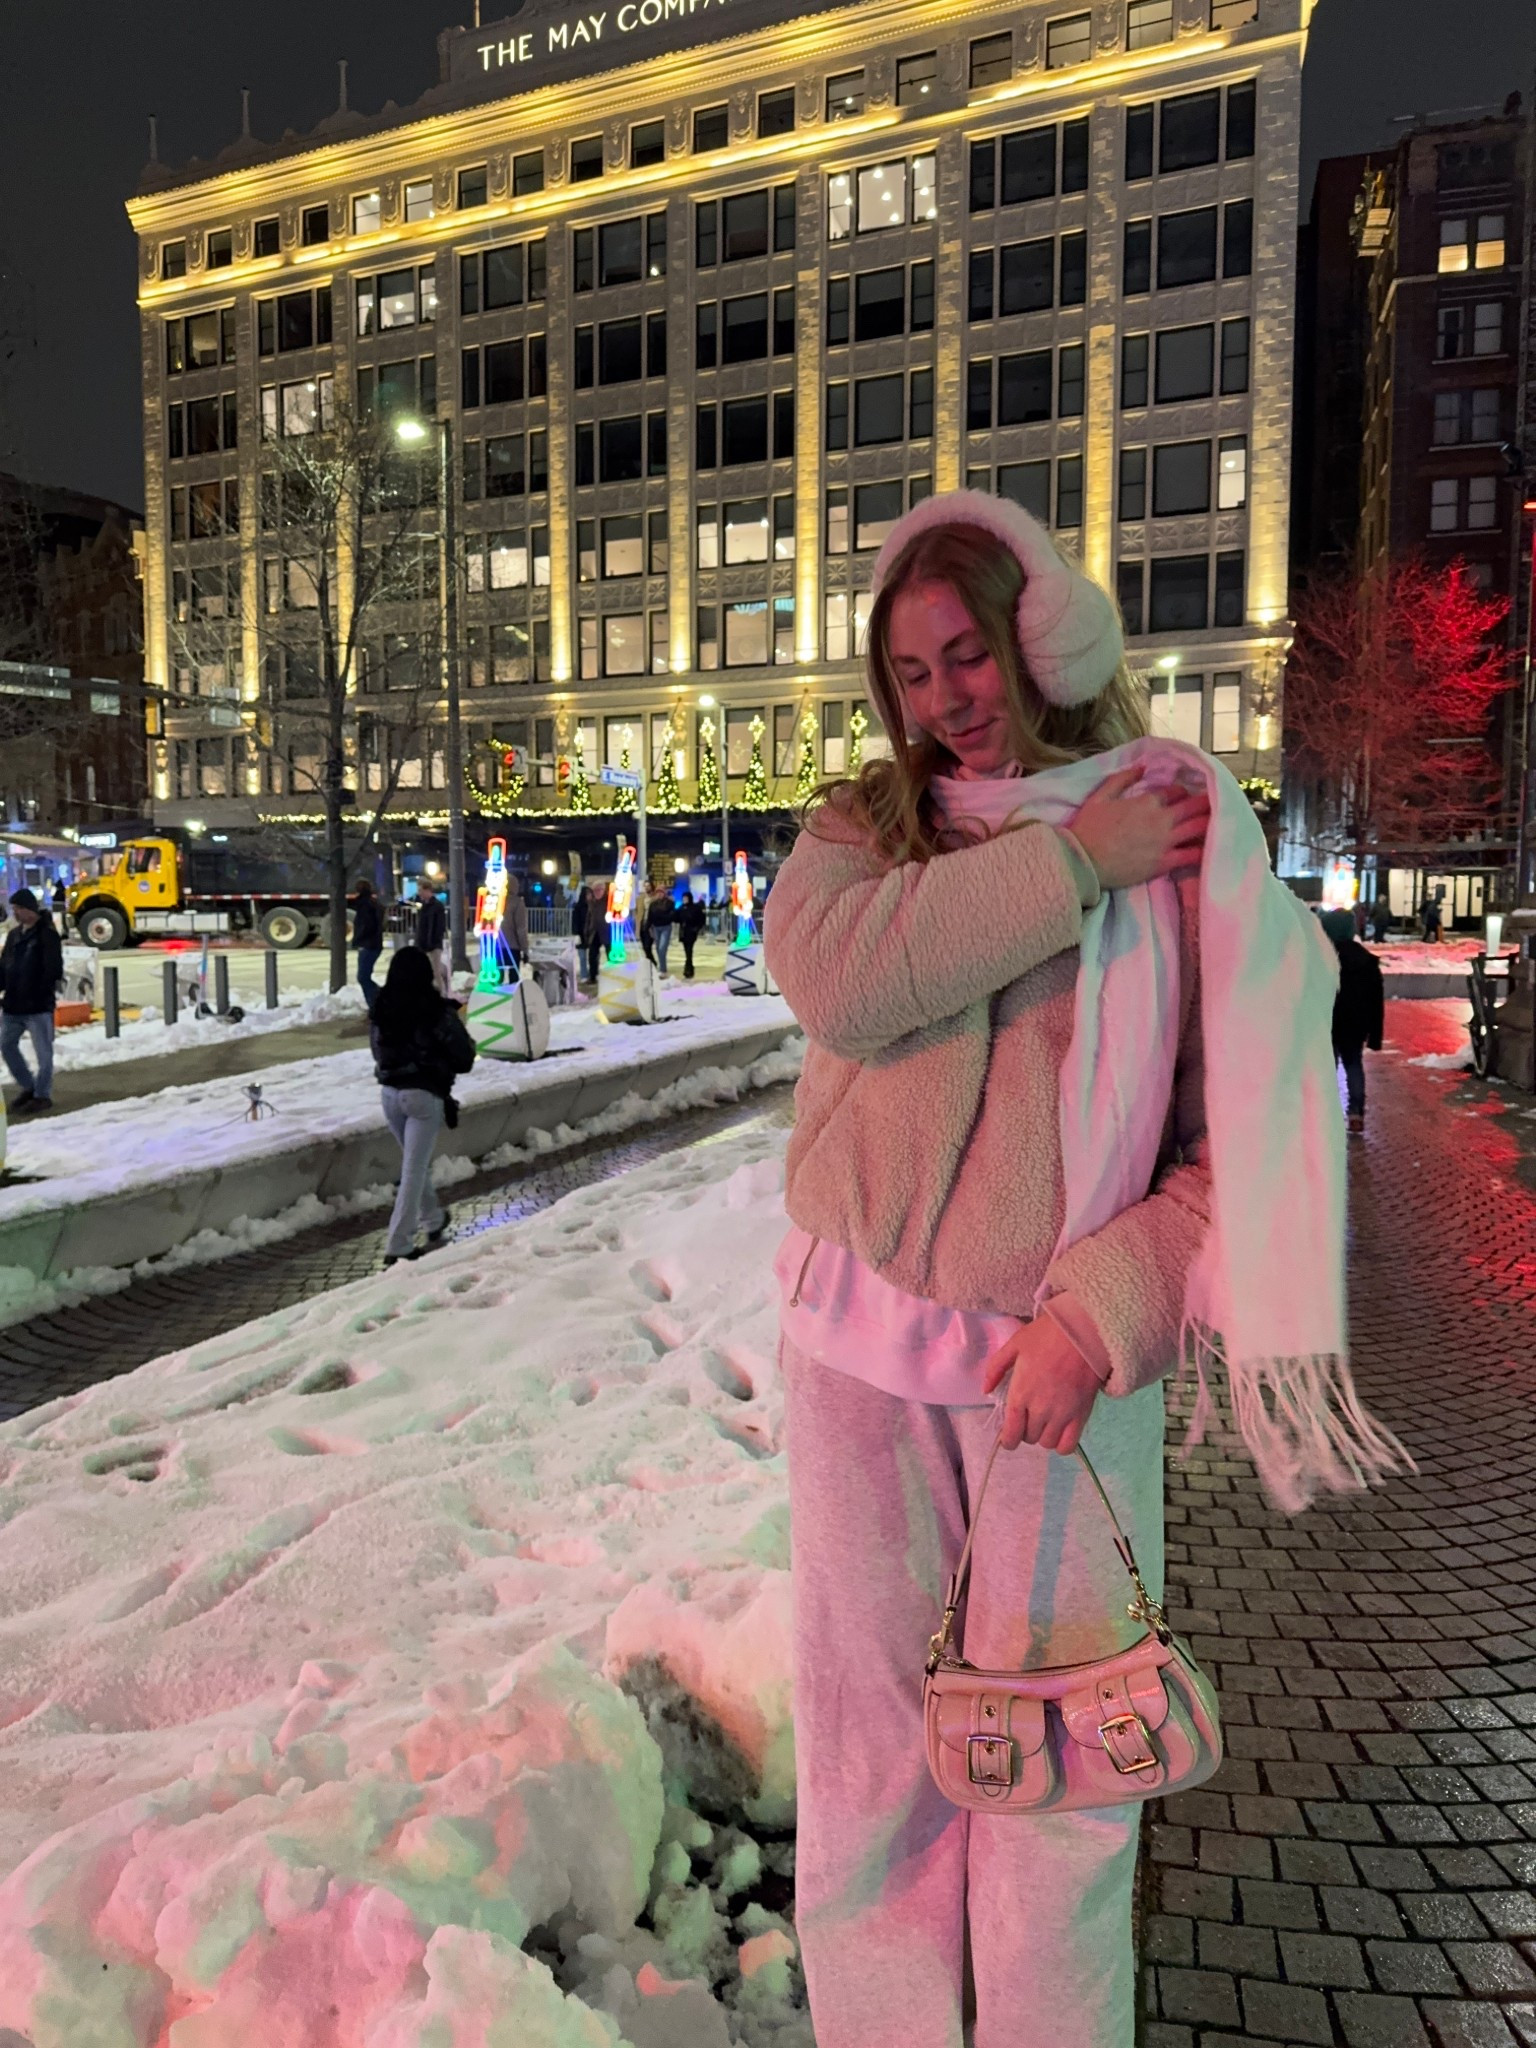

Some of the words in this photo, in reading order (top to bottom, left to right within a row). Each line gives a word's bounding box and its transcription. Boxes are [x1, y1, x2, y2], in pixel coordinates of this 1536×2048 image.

[477, 33, 533, 71] THE
[548, 11, 607, 53] MAY
[617, 0, 725, 32] COMP
